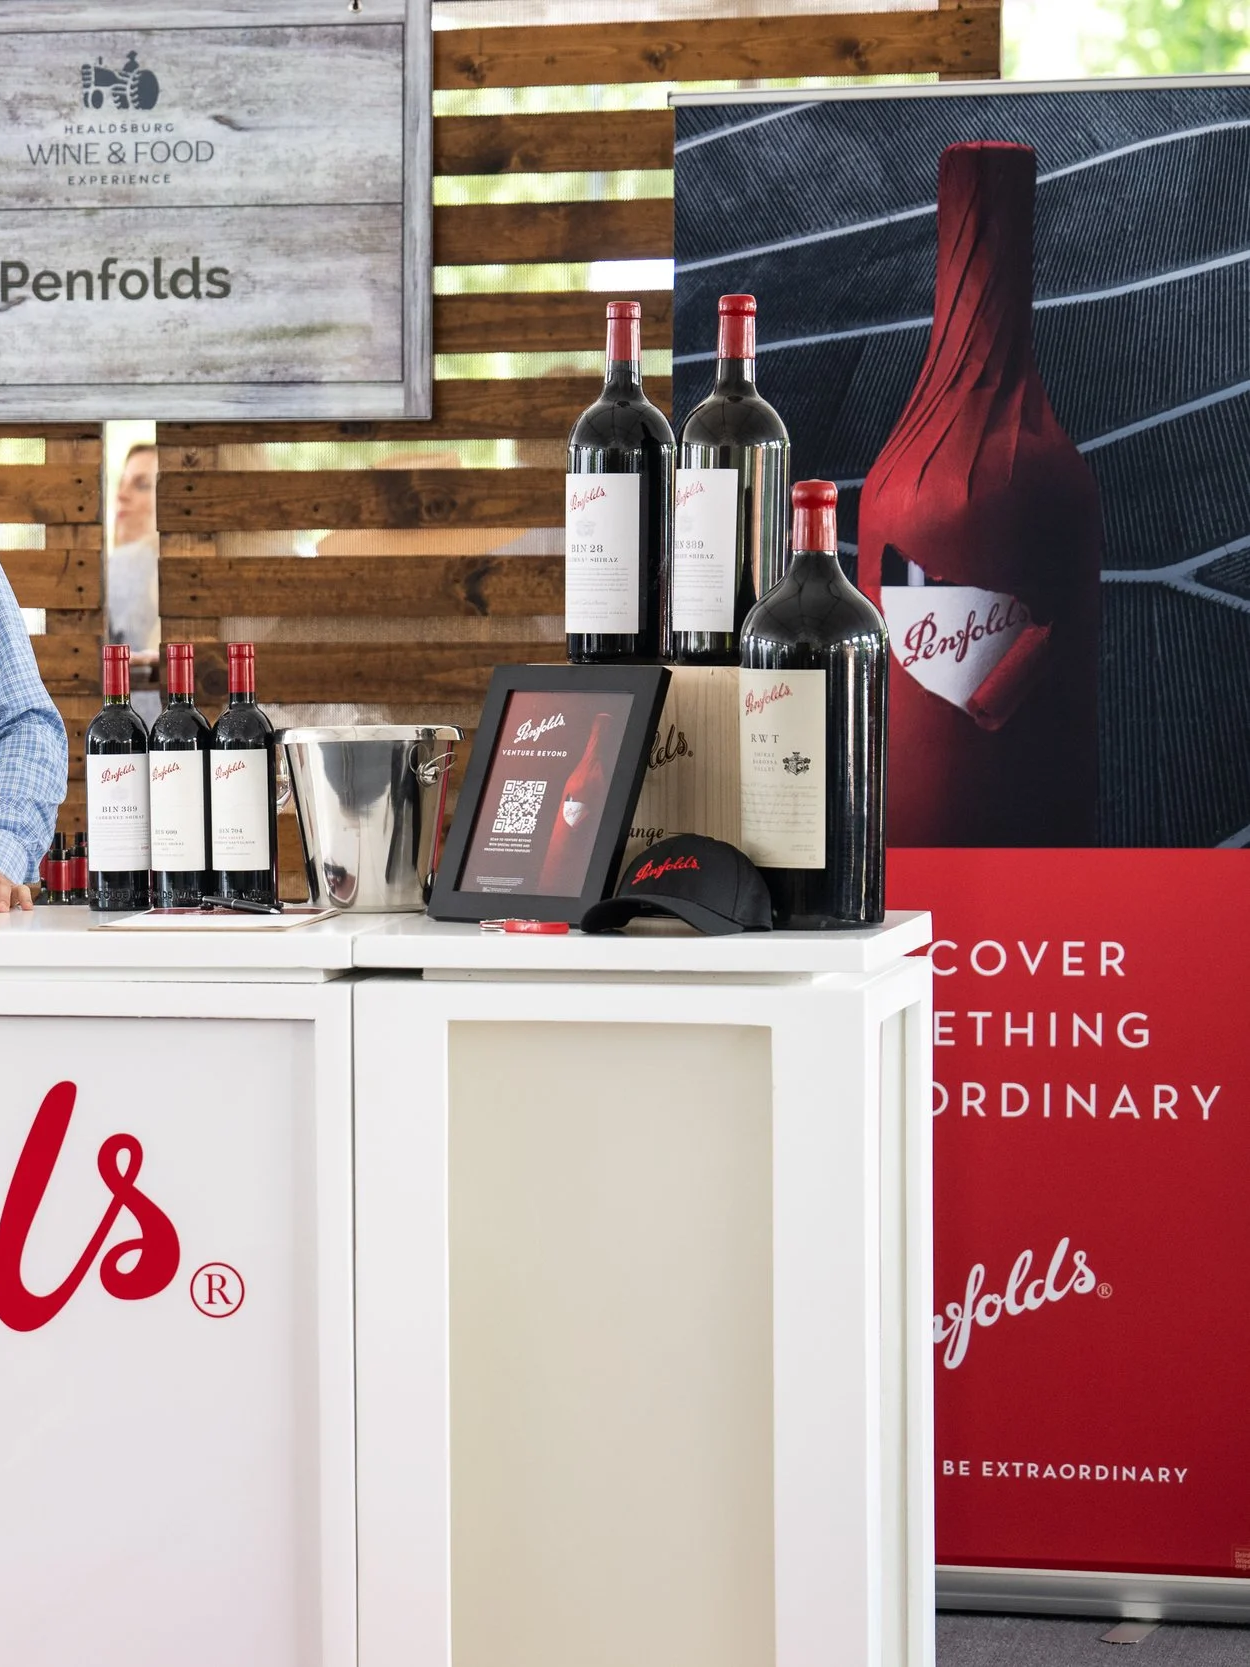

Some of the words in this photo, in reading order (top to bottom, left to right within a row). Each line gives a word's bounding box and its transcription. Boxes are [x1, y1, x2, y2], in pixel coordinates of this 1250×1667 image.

[63, 123, 175, 135] HEALDSBURG
[26, 142, 101, 166] WINE
[107, 141, 127, 165] &
[134, 140, 215, 164] FOOD
[67, 173, 172, 186] EXPERIENCE
[0, 257, 232, 303] Penfolds
[589, 543, 604, 553] 28
[902, 600, 1029, 668] Penfolds
[744, 682, 793, 716] Penfolds
[513, 712, 566, 744] Penfolds
[502, 749, 535, 757] VENTURE
[101, 763, 137, 784] Penfolds
[121, 805, 138, 813] 389
[631, 855, 699, 885] Penfolds
[926, 940, 1126, 977] COVER
[934, 1011, 1150, 1049] ETHING
[943, 1460, 970, 1476] BE
[981, 1461, 1189, 1484] EXTRAORDINARY
